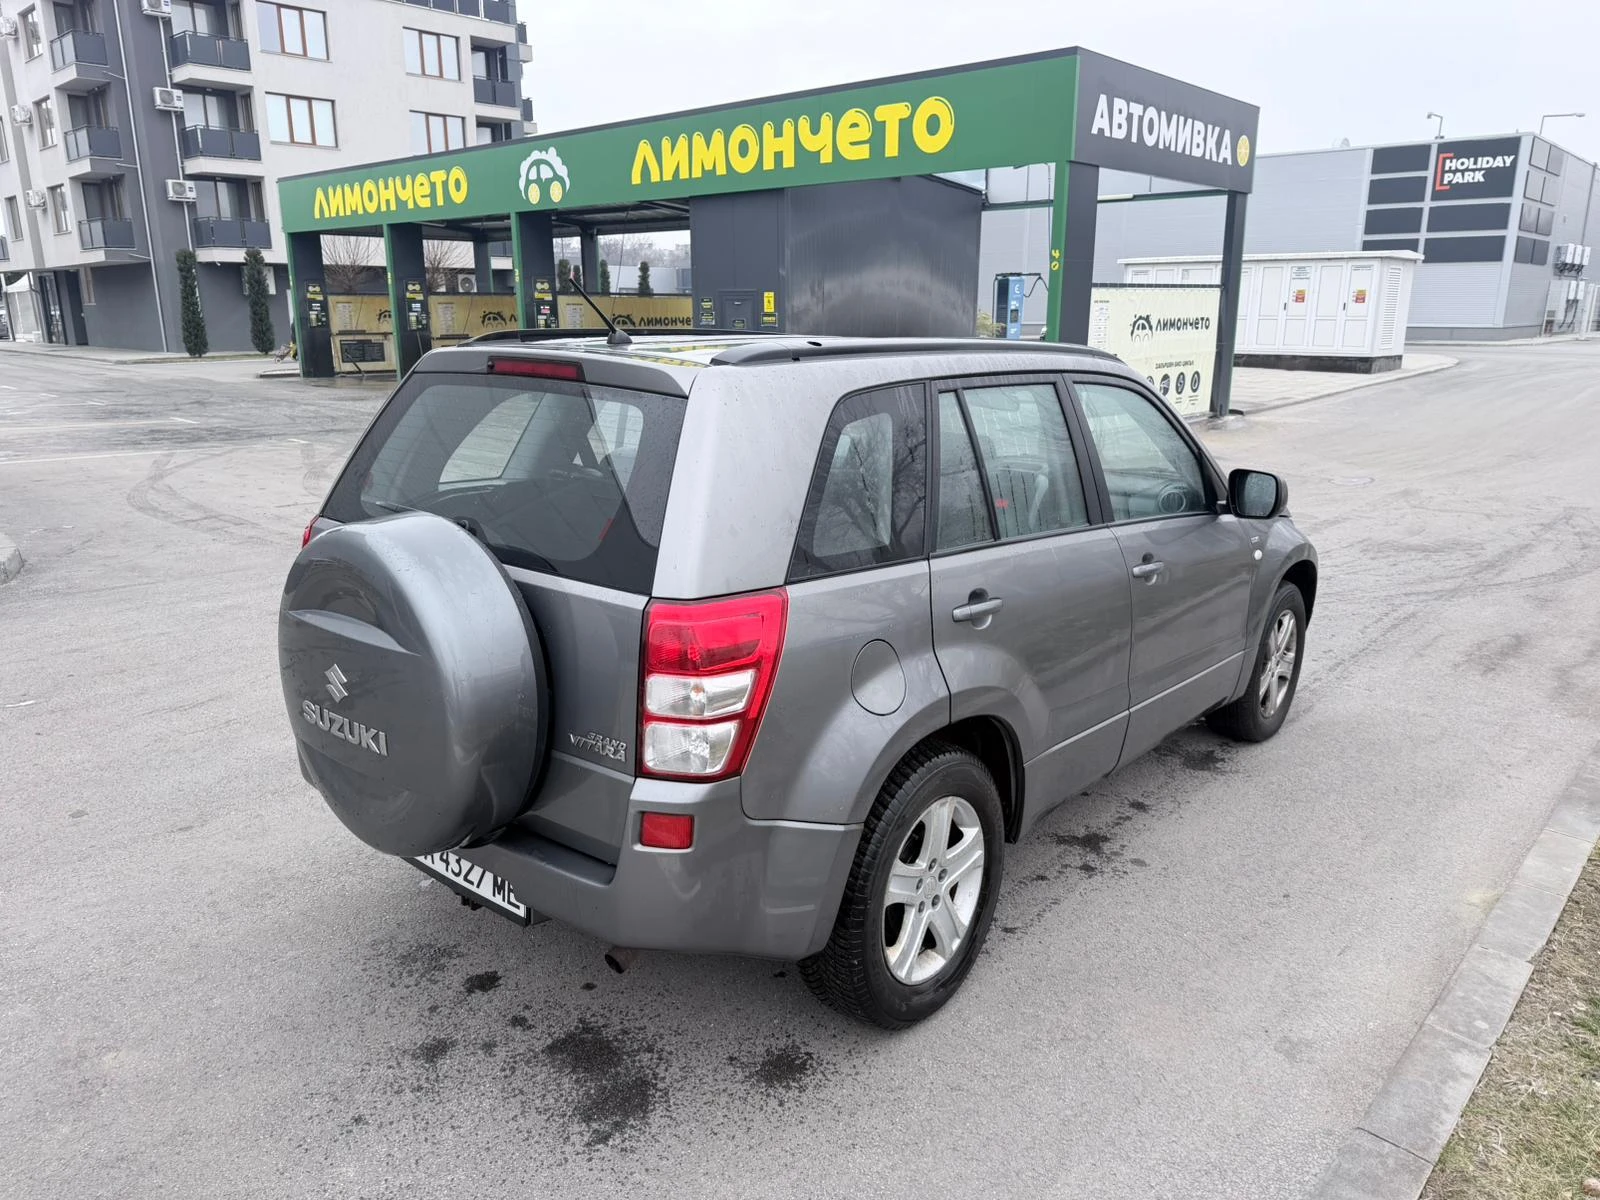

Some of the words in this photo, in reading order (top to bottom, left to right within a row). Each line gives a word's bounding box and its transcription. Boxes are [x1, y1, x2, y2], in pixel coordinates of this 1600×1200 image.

[1091, 94, 1232, 165] АВТОМИВКА
[1444, 155, 1515, 171] HOLIDAY
[1443, 170, 1486, 184] PARK
[302, 700, 388, 756] SUZUKI
[587, 732, 627, 751] GRAND
